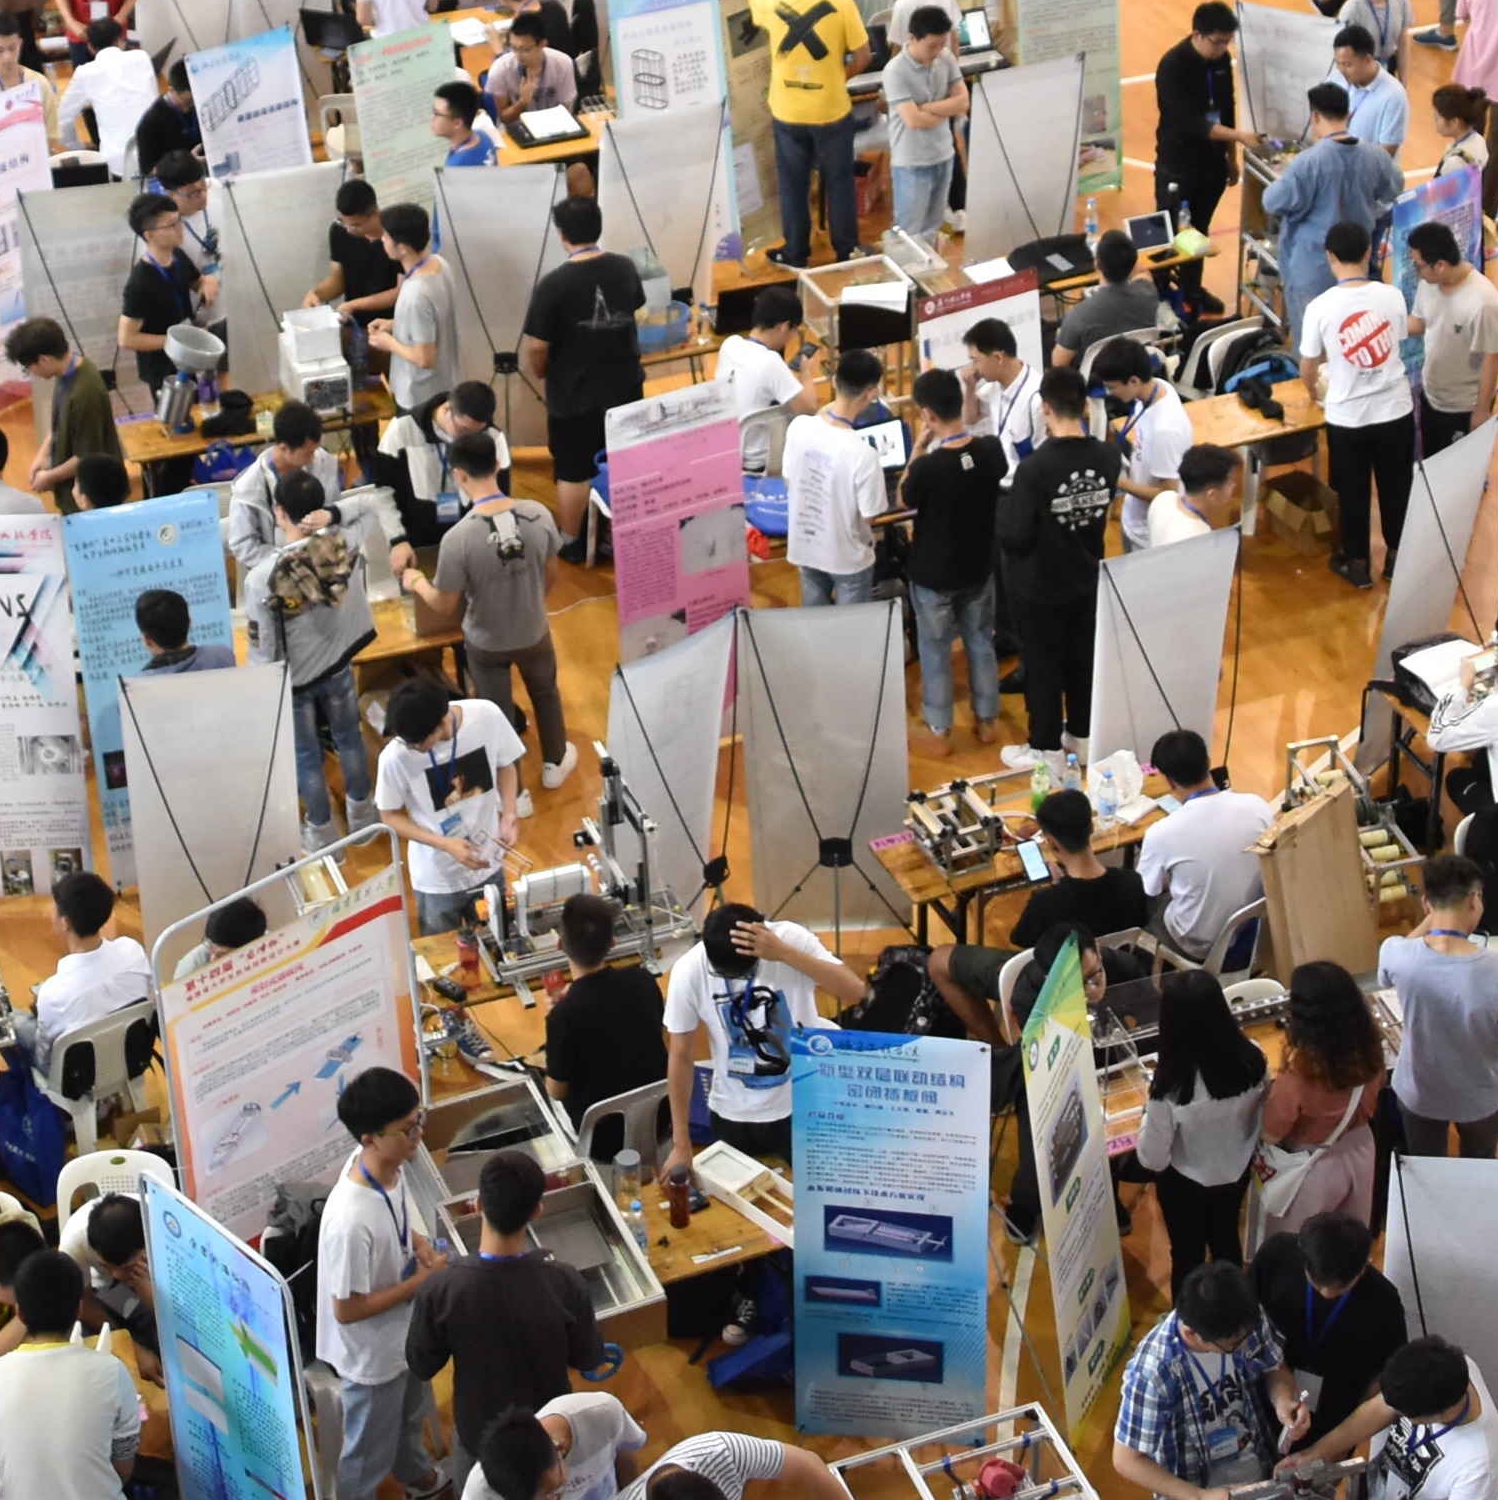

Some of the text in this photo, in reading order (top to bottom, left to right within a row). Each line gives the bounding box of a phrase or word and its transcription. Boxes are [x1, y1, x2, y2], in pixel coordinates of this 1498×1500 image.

[818, 1062, 966, 1088] 新型双层联动结构
[847, 1083, 938, 1104] 密闭插板阀
